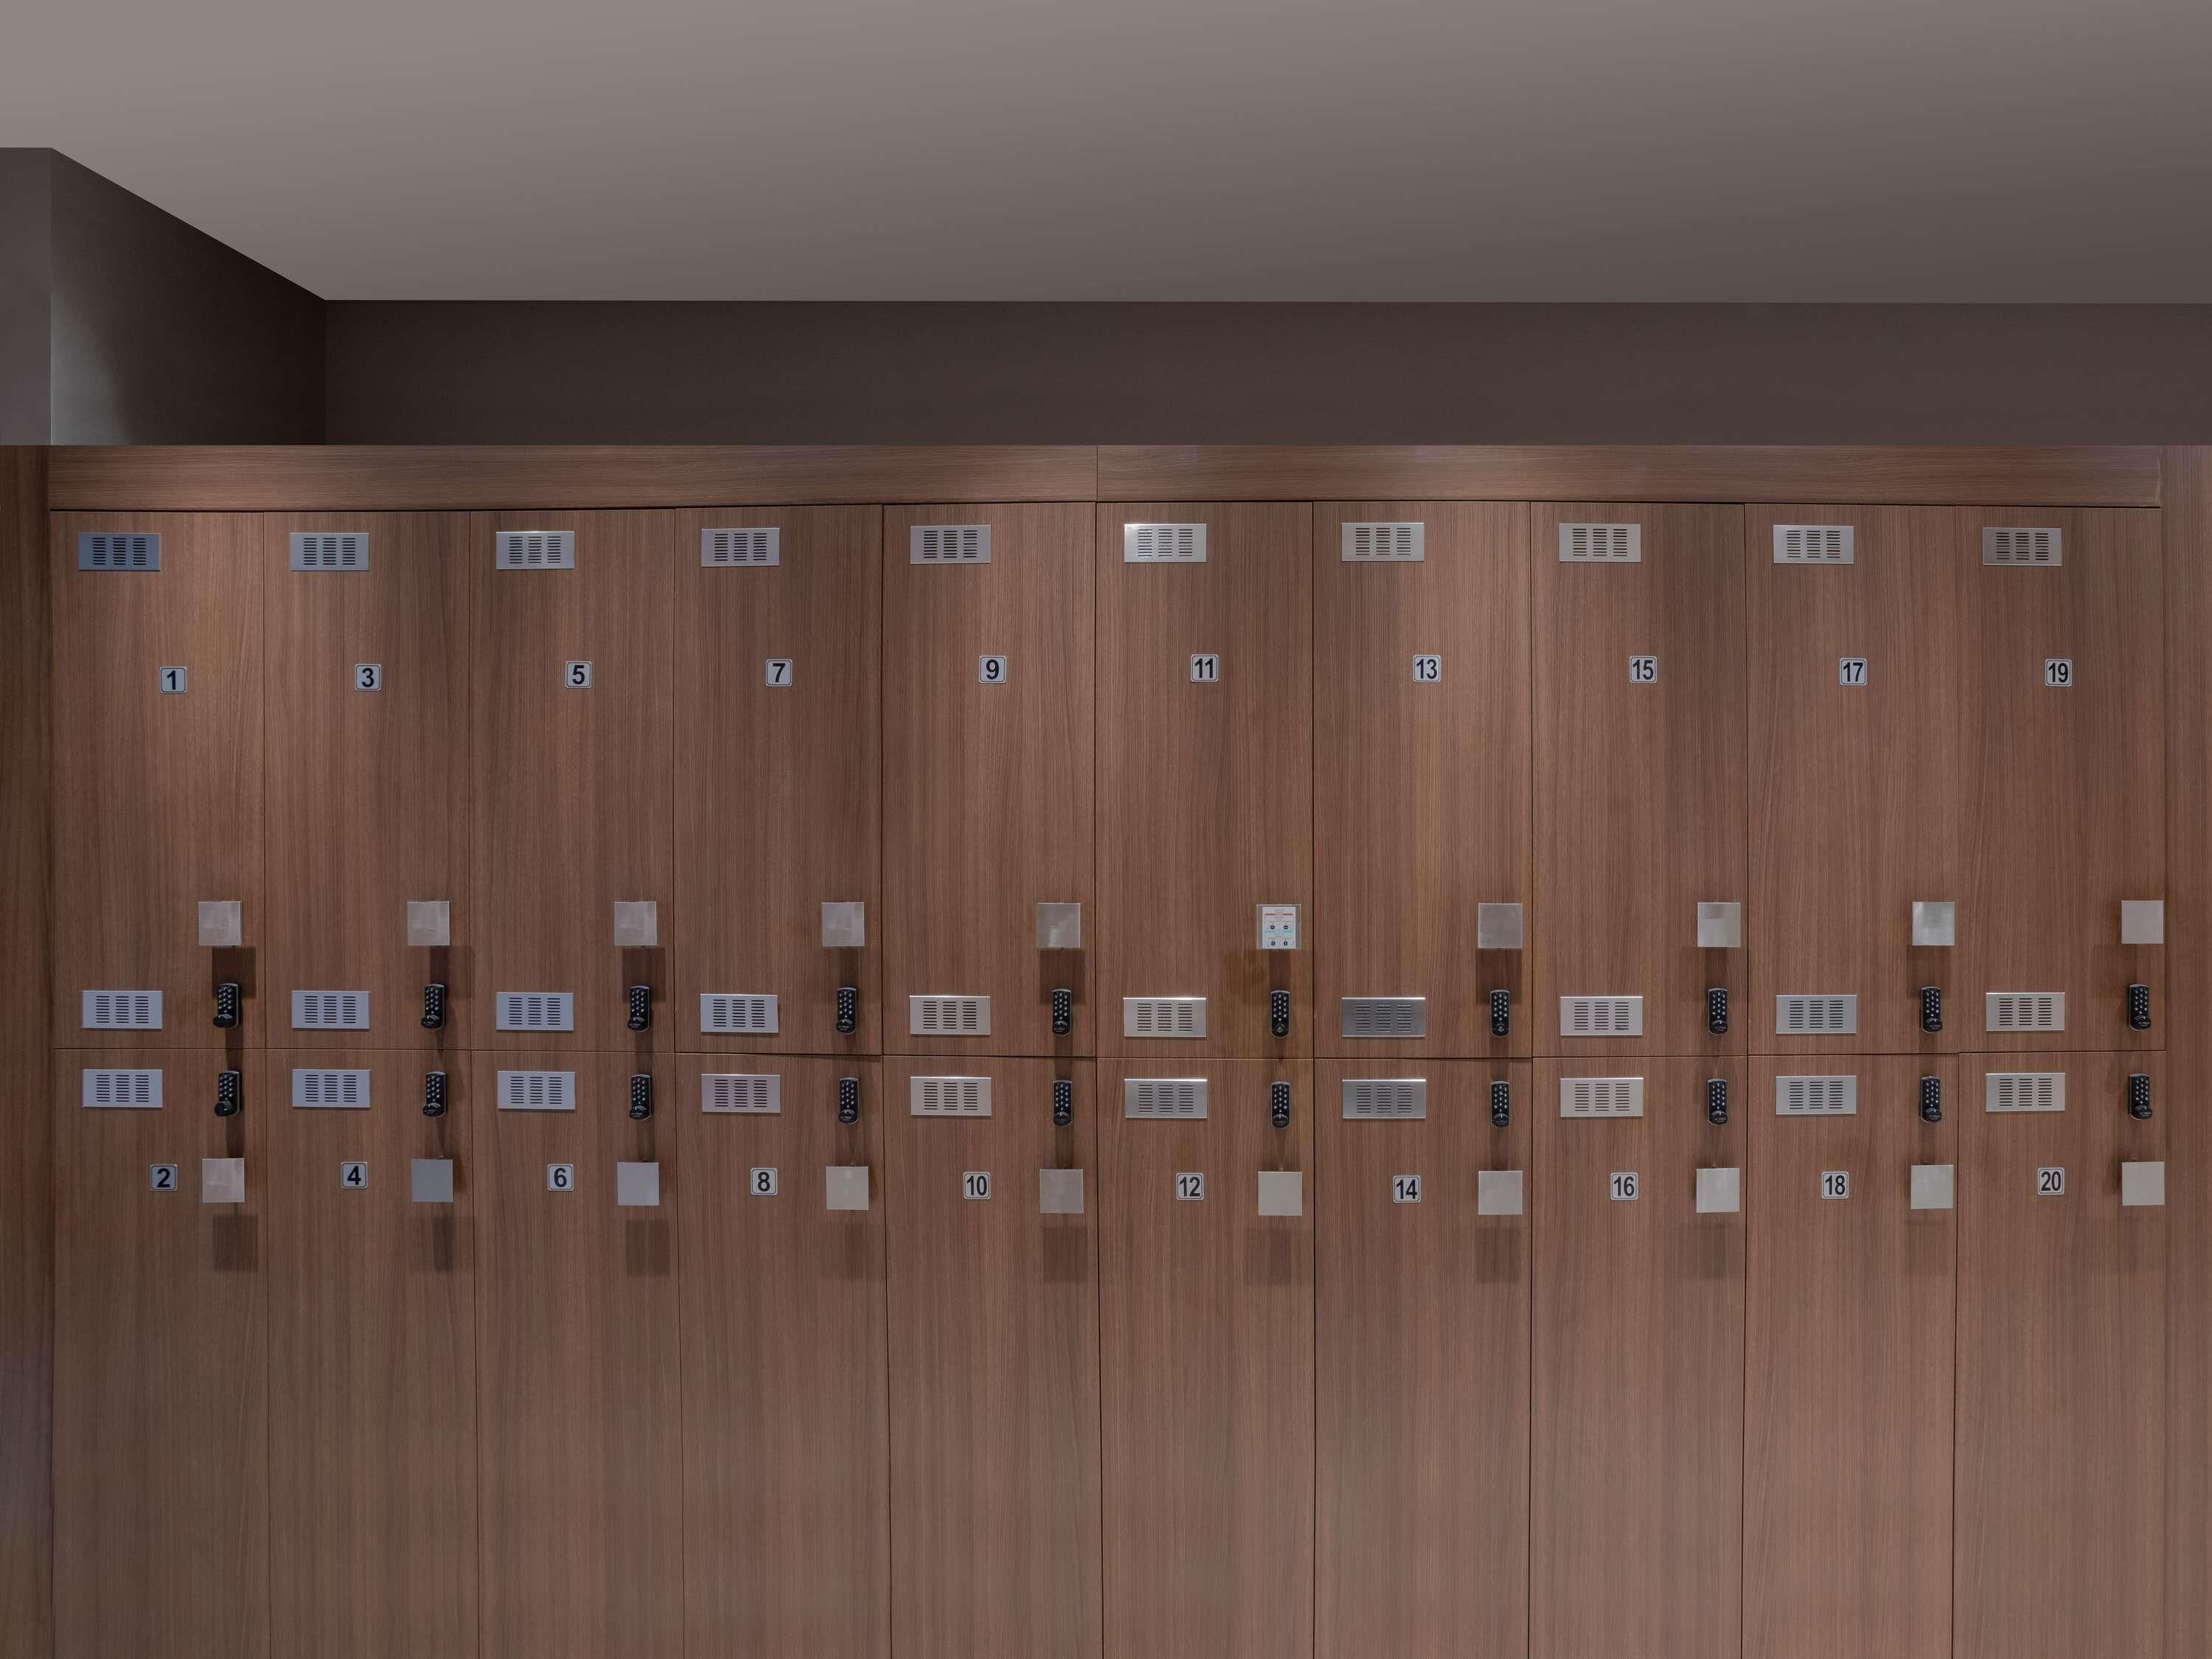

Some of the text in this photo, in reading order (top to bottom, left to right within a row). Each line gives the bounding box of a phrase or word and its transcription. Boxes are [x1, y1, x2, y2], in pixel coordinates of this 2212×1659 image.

[361, 667, 375, 688] 3
[572, 664, 585, 685] 5
[772, 662, 786, 683] 7
[986, 659, 1000, 680] 9
[1194, 658, 1214, 678] 11
[1416, 658, 1438, 680] 13
[1632, 659, 1654, 681] 15
[1843, 661, 1864, 682] 17
[2048, 662, 2069, 684] 19
[167, 670, 176, 690] 1
[157, 1167, 170, 1188] 2
[347, 1165, 361, 1186] 4
[554, 1167, 567, 1188] 6
[757, 1172, 771, 1192] 8
[966, 1175, 987, 1196] 10
[1825, 1175, 1846, 1195] 18
[2041, 1171, 2062, 1192] 20
[1179, 1176, 1200, 1197] 12
[1396, 1179, 1418, 1200] 14
[1613, 1176, 1635, 1197] 16
